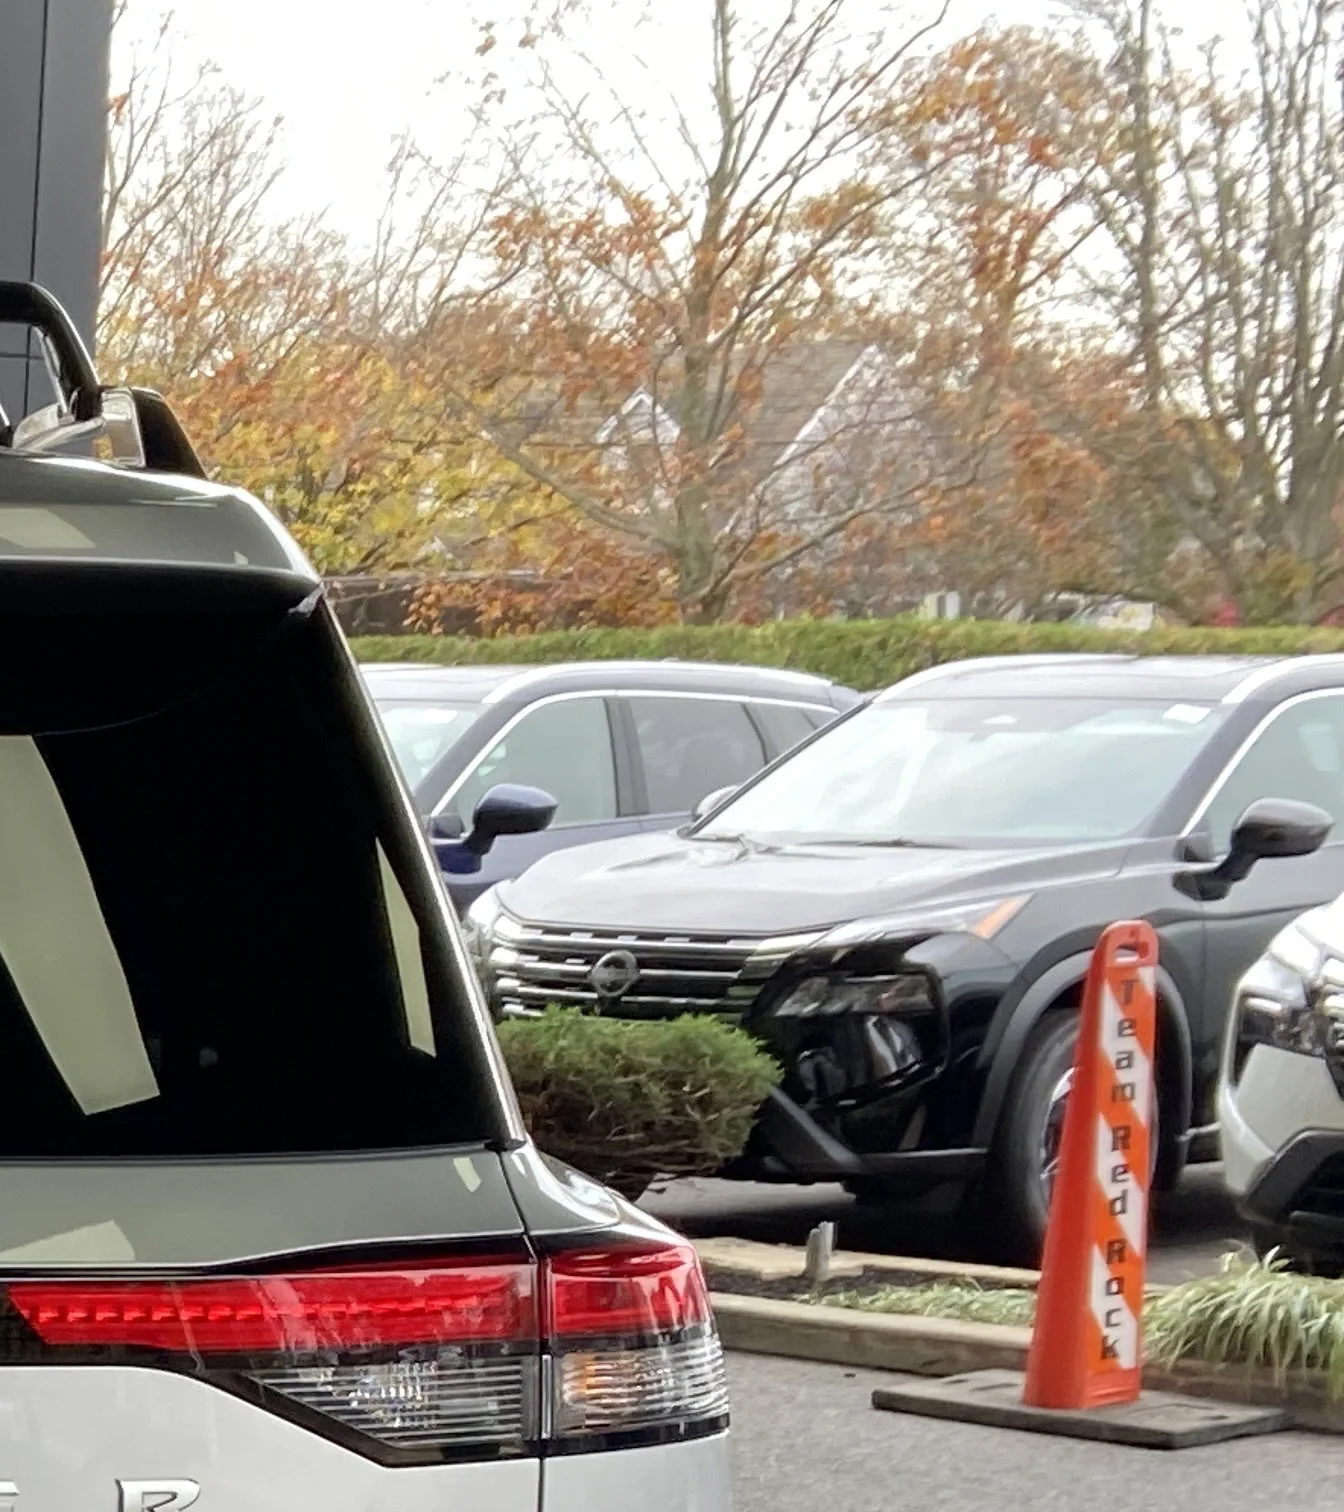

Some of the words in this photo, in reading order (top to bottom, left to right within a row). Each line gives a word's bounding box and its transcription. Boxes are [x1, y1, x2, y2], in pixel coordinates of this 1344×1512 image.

[1110, 978, 1140, 1100] Team
[1108, 1125, 1132, 1216] Red
[1099, 1238, 1125, 1361] Rock
